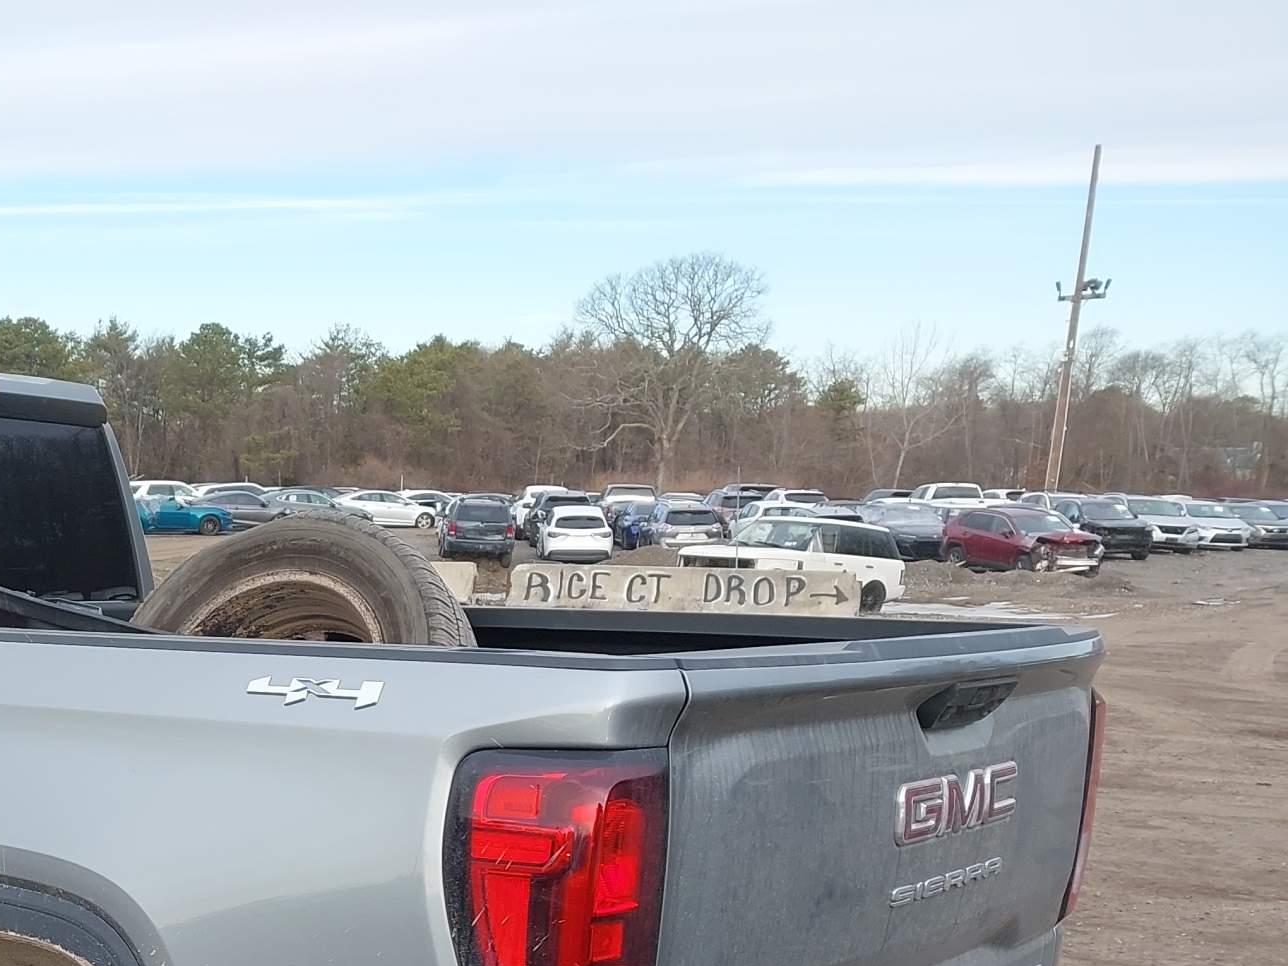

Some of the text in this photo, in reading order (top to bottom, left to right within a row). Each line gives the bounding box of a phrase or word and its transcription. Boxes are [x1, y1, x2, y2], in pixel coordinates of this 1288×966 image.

[702, 571, 807, 607] DROP
[895, 760, 1018, 848] GMC
[889, 856, 1003, 908] SIERRA
